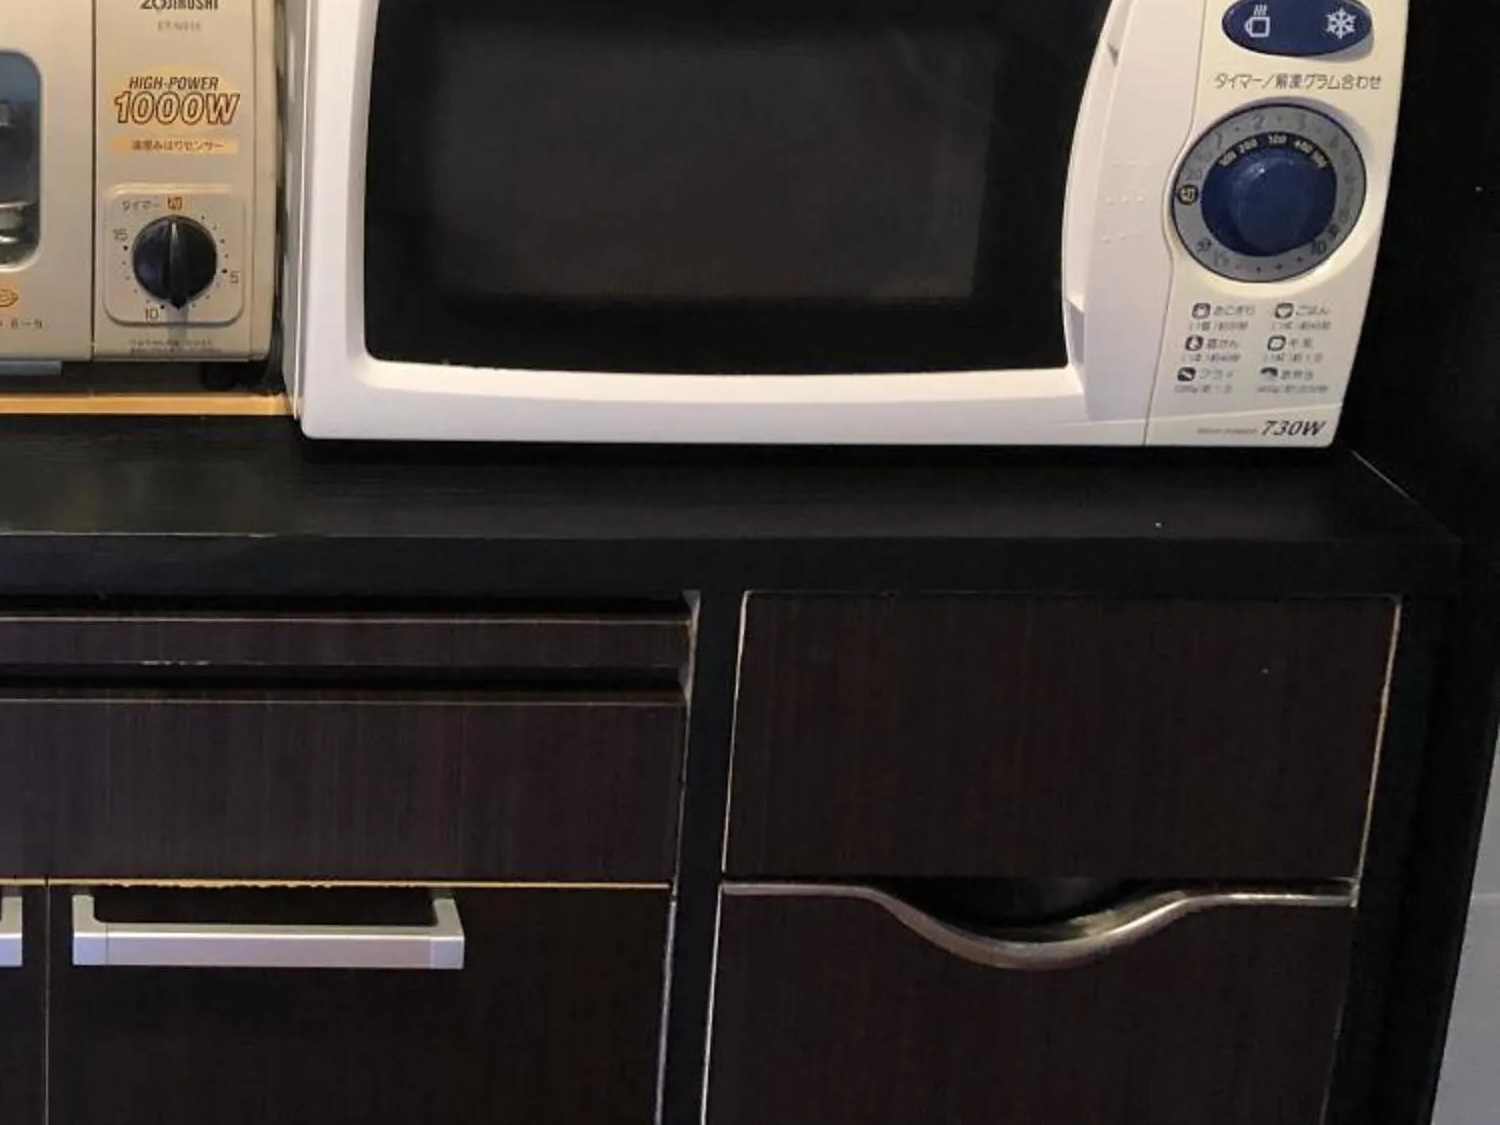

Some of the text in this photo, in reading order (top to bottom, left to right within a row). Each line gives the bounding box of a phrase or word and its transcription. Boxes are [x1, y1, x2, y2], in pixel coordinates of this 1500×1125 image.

[129, 76, 220, 90] HIGH-POWER
[114, 91, 241, 125] 1000W
[122, 201, 162, 210] タイマー
[113, 228, 129, 241] 15
[230, 270, 239, 285] 5
[145, 308, 159, 320] 10
[1261, 420, 1327, 436] 730W
